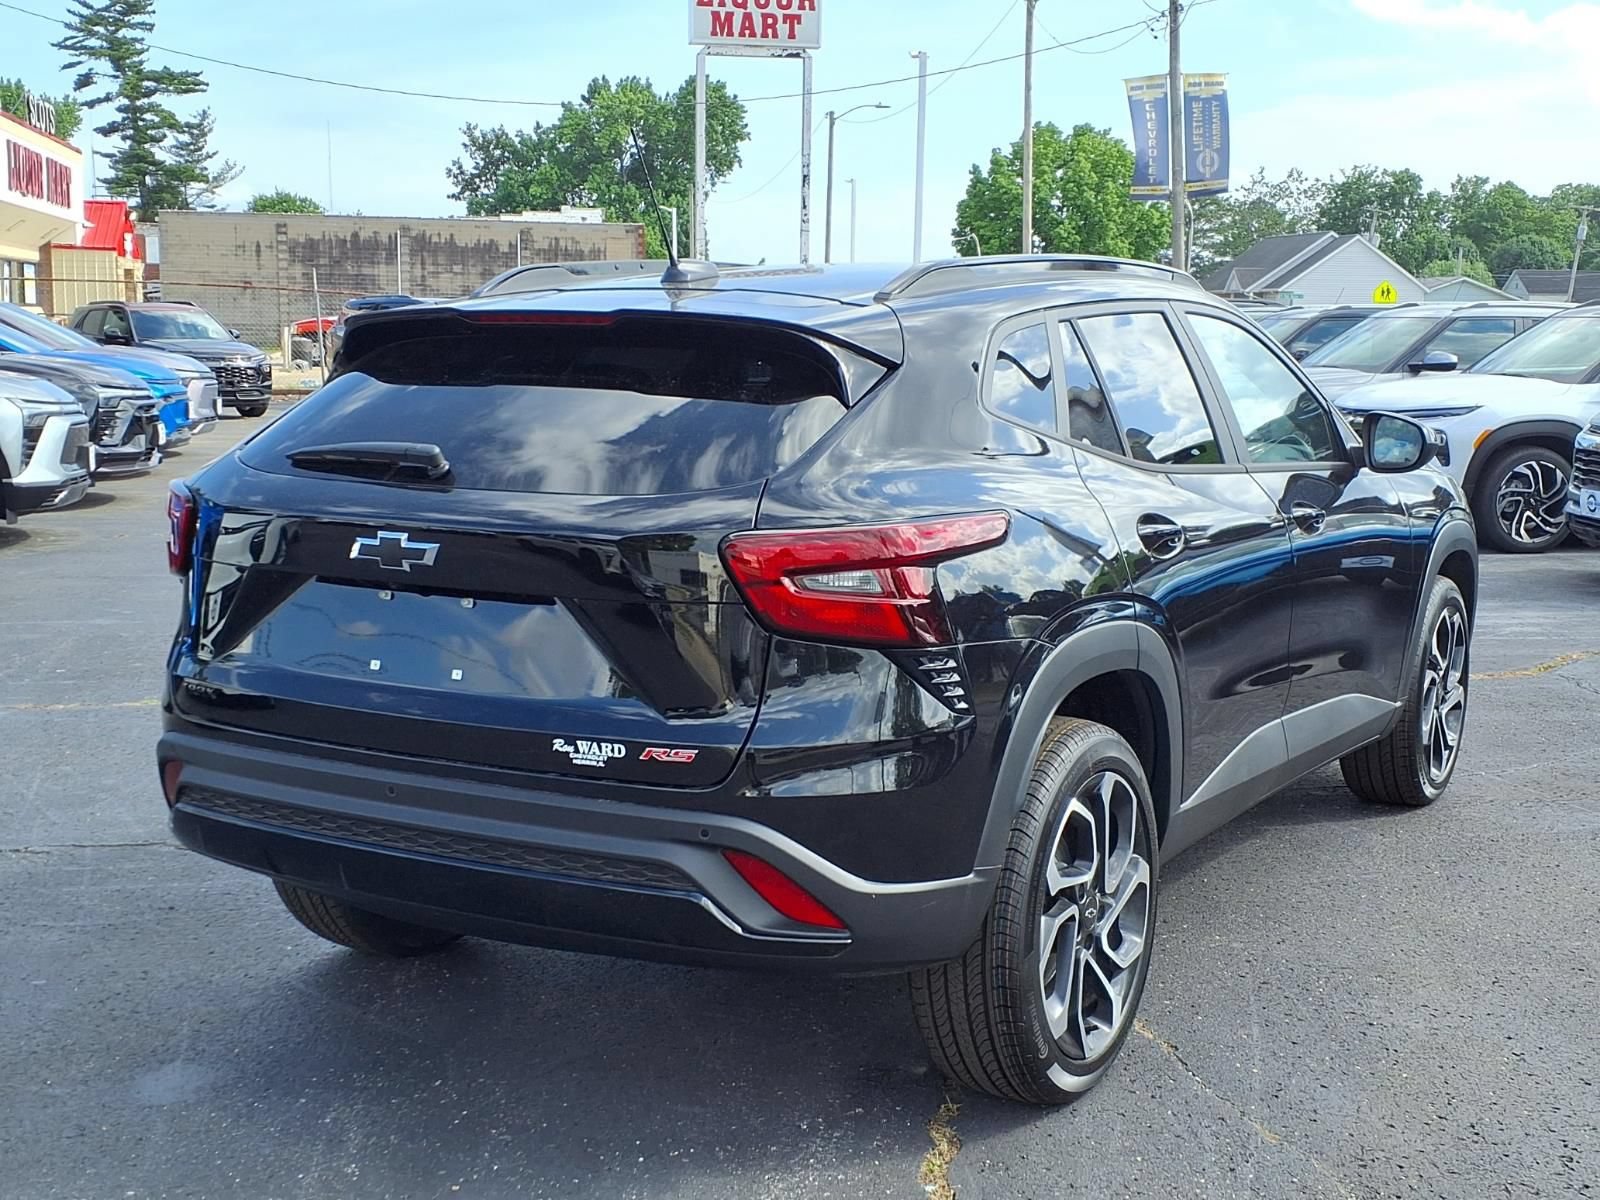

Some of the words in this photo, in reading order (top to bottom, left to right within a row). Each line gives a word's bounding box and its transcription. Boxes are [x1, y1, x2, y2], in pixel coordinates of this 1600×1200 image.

[710, 11, 802, 39] MART
[27, 94, 55, 135] SLOTS
[1192, 100, 1204, 151] LIFETIME
[1211, 100, 1221, 150] WARRANTY
[1144, 103, 1158, 184] CHEVROLET
[6, 139, 44, 200] LIQUOR
[46, 156, 72, 209] MART
[552, 738, 575, 752] Ron
[576, 740, 626, 758] WARD
[569, 752, 608, 761] CHEVROLET
[639, 747, 699, 763] RS
